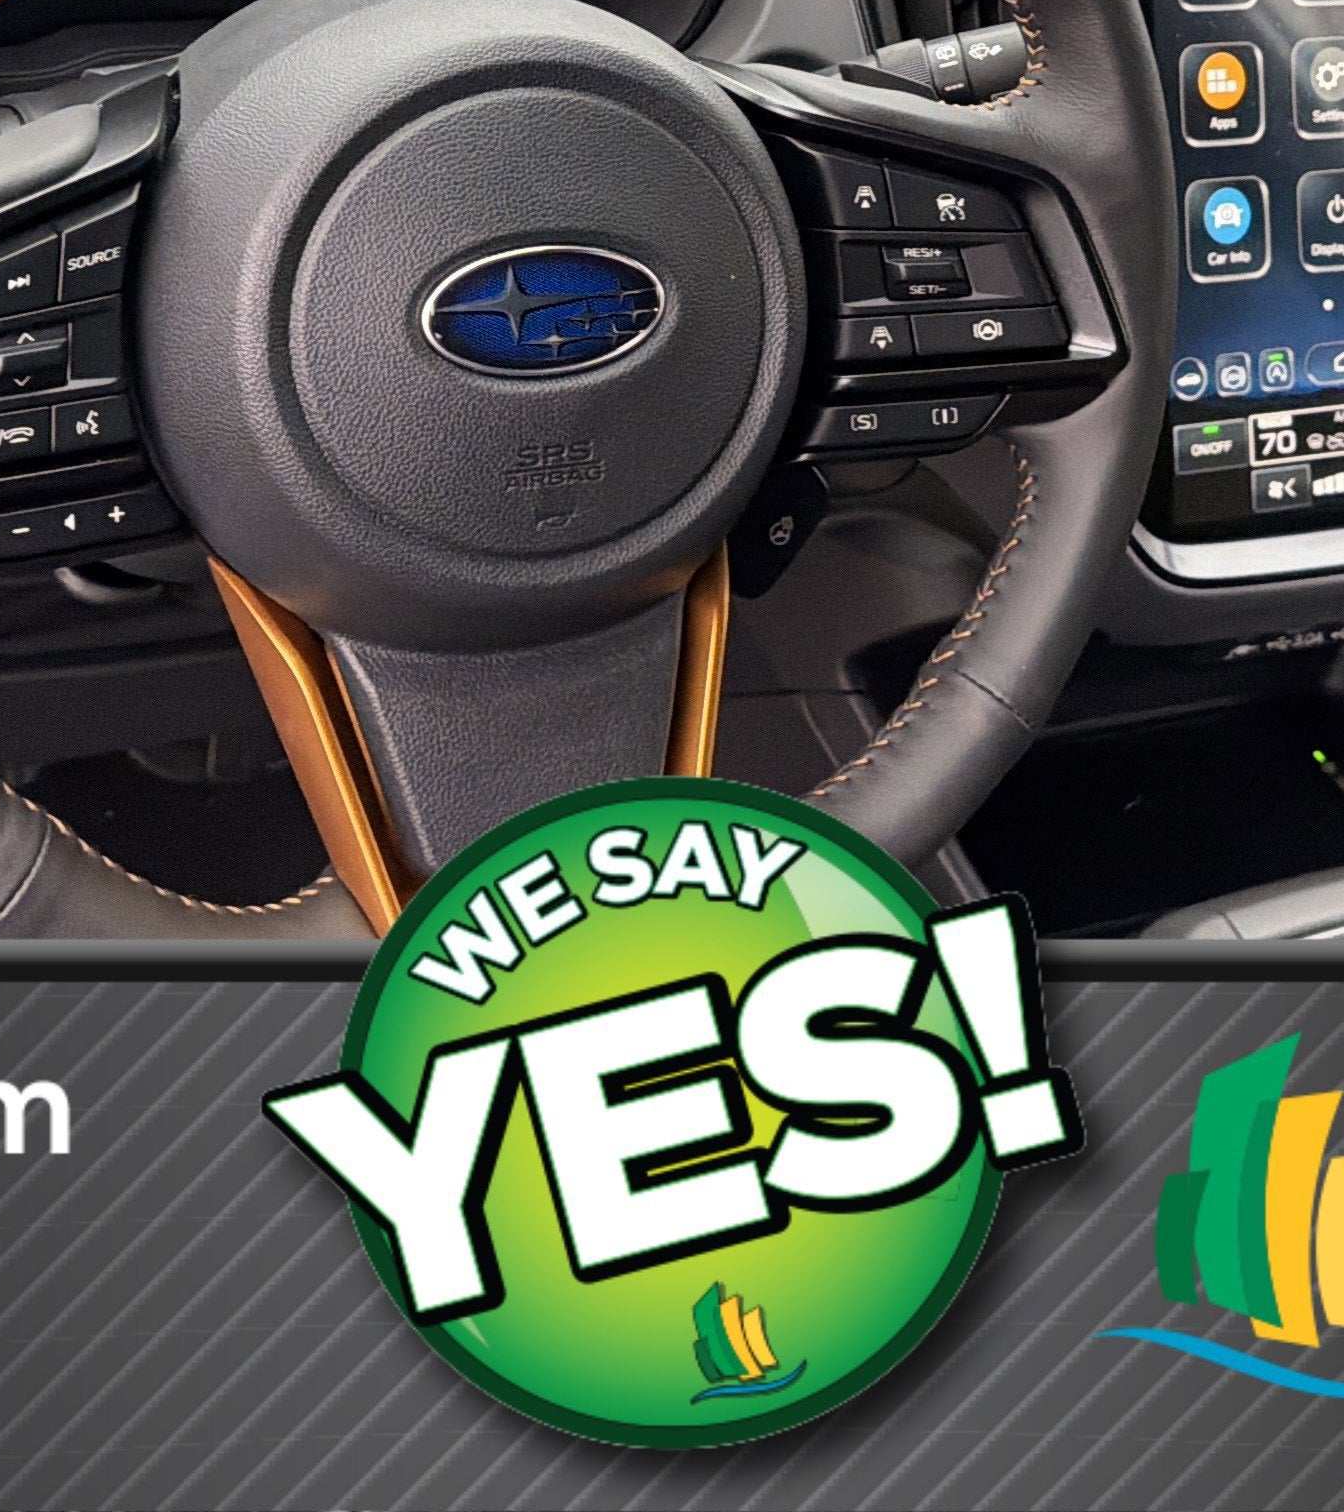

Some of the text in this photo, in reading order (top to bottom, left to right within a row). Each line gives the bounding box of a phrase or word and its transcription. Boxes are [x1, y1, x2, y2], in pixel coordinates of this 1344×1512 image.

[1209, 116, 1237, 134] Apps
[67, 246, 122, 272] SOURCE
[517, 442, 594, 466] SRS
[1259, 430, 1297, 456] 70
[507, 469, 607, 491] AIRBAG
